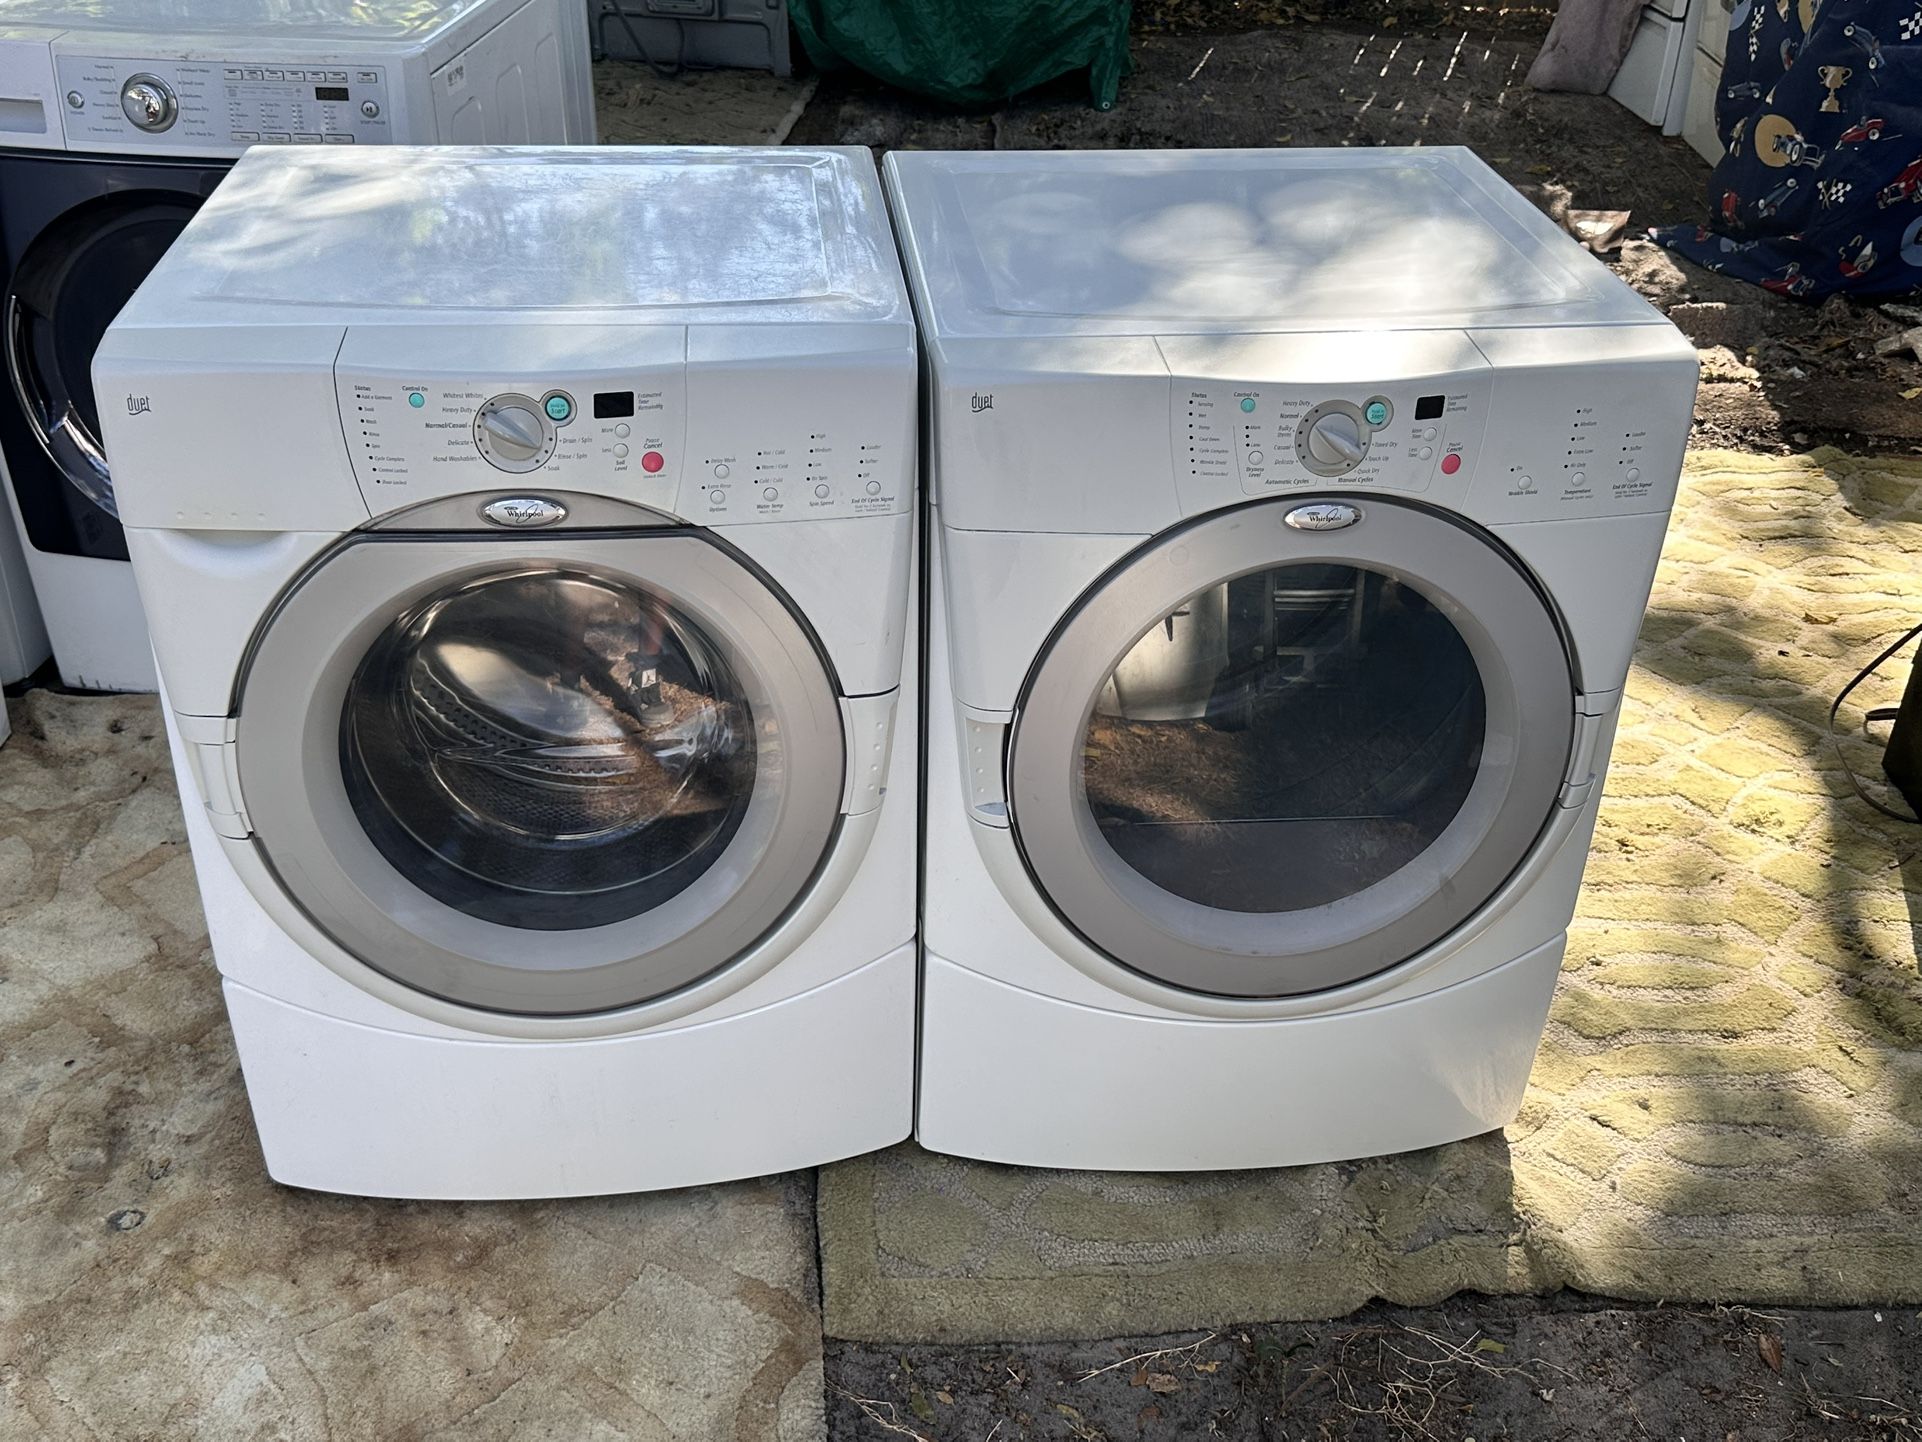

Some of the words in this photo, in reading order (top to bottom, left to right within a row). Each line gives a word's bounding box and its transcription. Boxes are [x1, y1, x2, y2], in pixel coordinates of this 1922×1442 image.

[127, 393, 151, 415] duet
[972, 392, 993, 412] duet
[1358, 476, 1374, 484] Cycles
[506, 509, 544, 519] Whirlpool
[1309, 514, 1342, 523] Whirlpool
